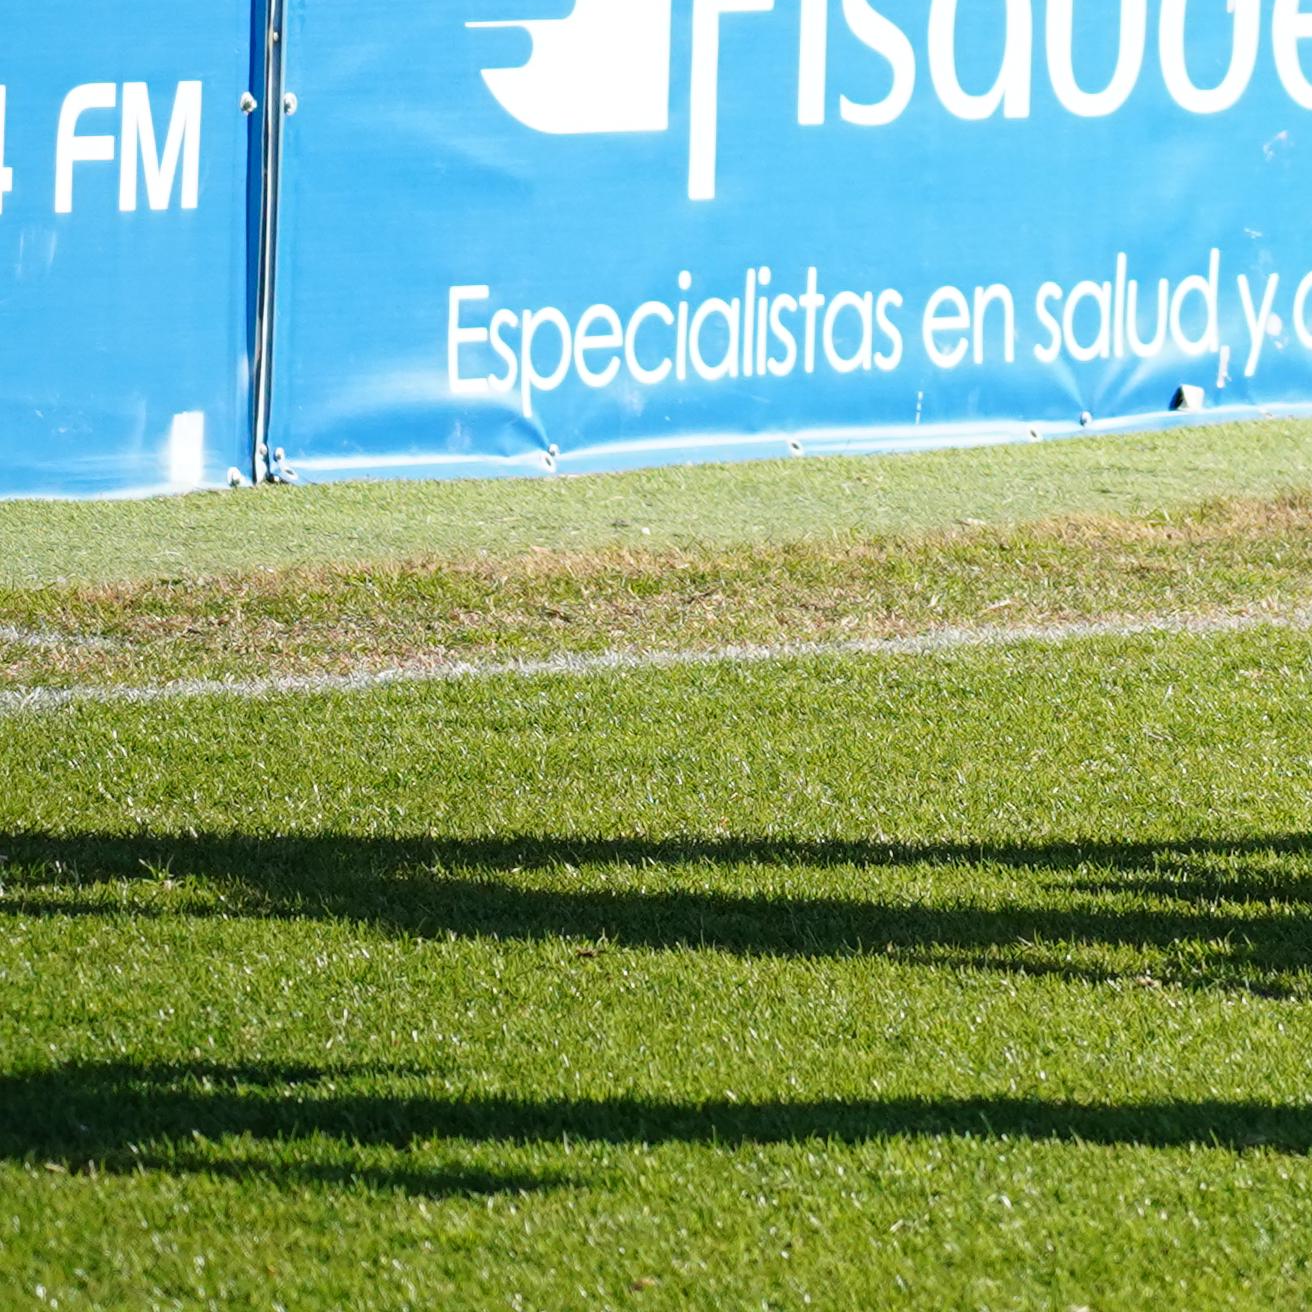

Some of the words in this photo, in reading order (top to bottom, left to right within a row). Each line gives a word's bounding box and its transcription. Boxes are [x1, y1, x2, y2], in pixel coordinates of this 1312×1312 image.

[54, 79, 203, 214] FM
[447, 266, 904, 418] Especialistas
[921, 272, 1016, 373] en
[1237, 271, 1280, 377] y
